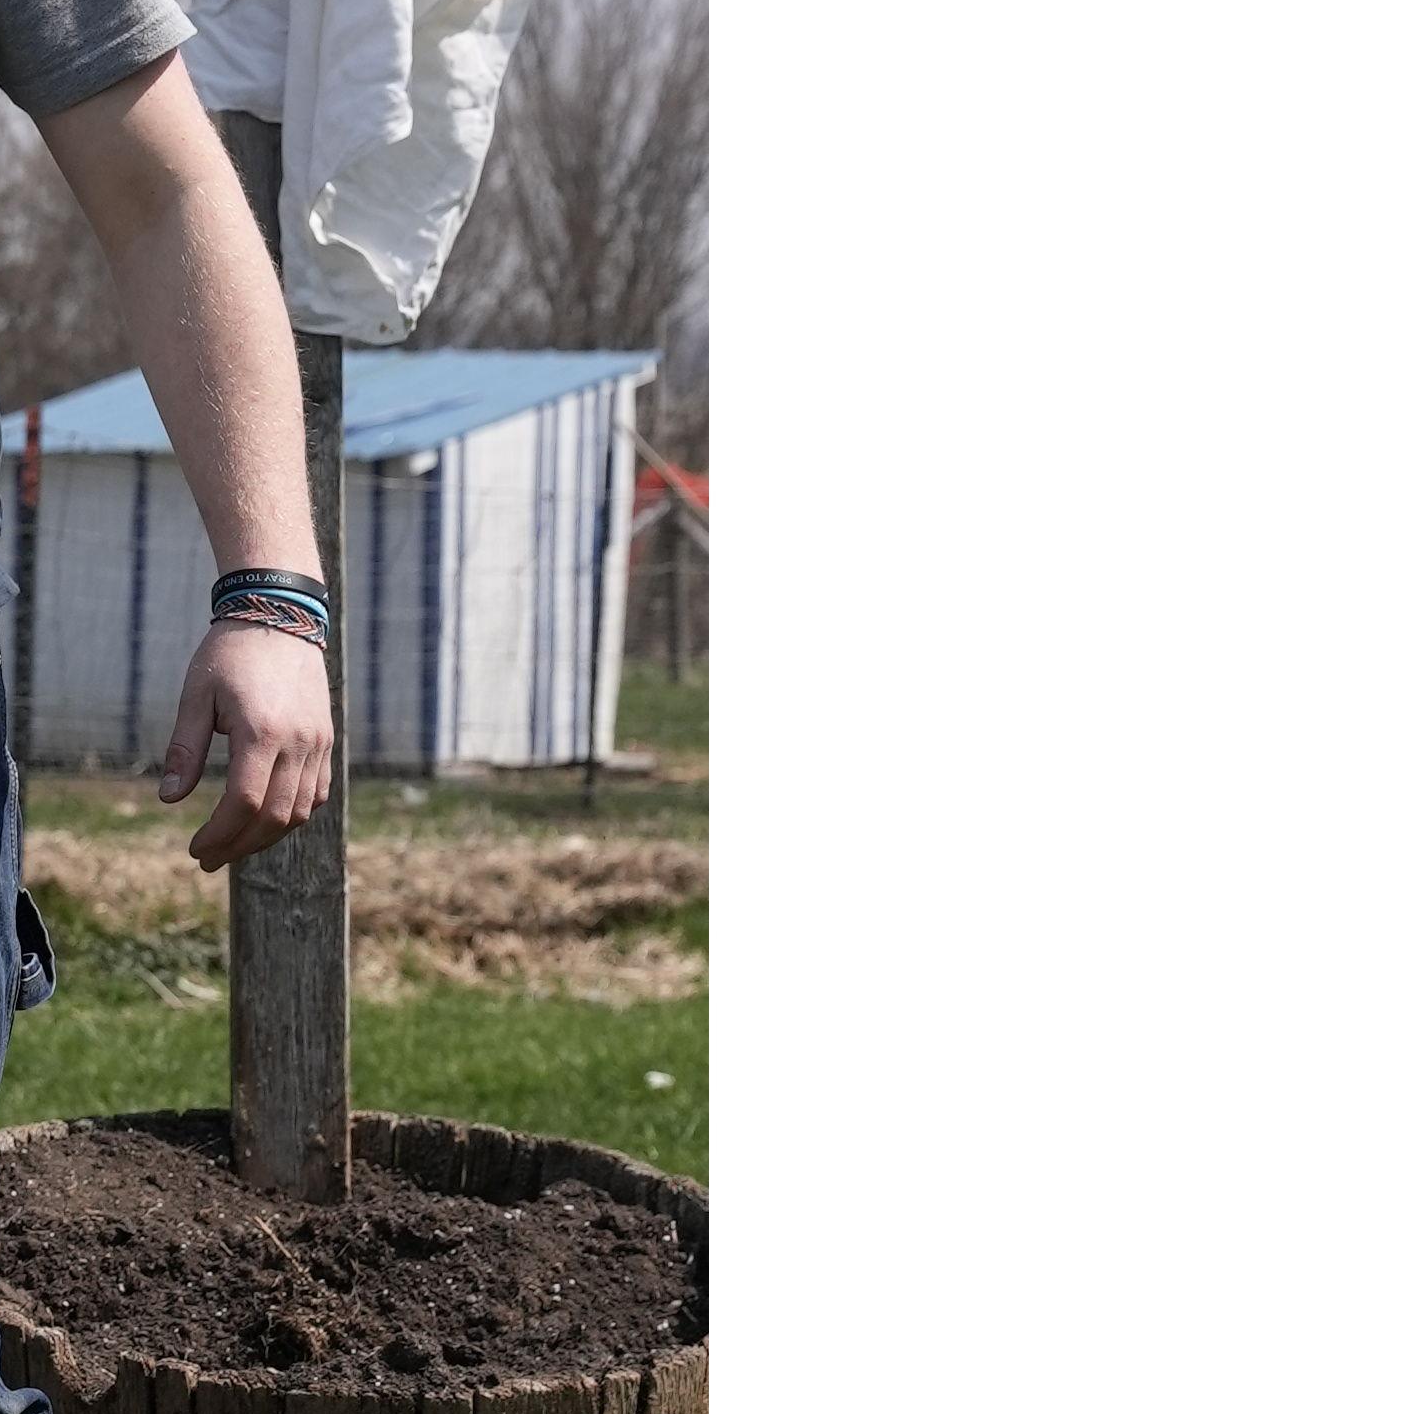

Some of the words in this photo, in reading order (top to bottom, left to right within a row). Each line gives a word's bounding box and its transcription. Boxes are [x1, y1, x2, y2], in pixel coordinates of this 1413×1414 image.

[224, 574, 244, 587] END
[245, 573, 263, 582] TO
[264, 573, 293, 585] PRAY
